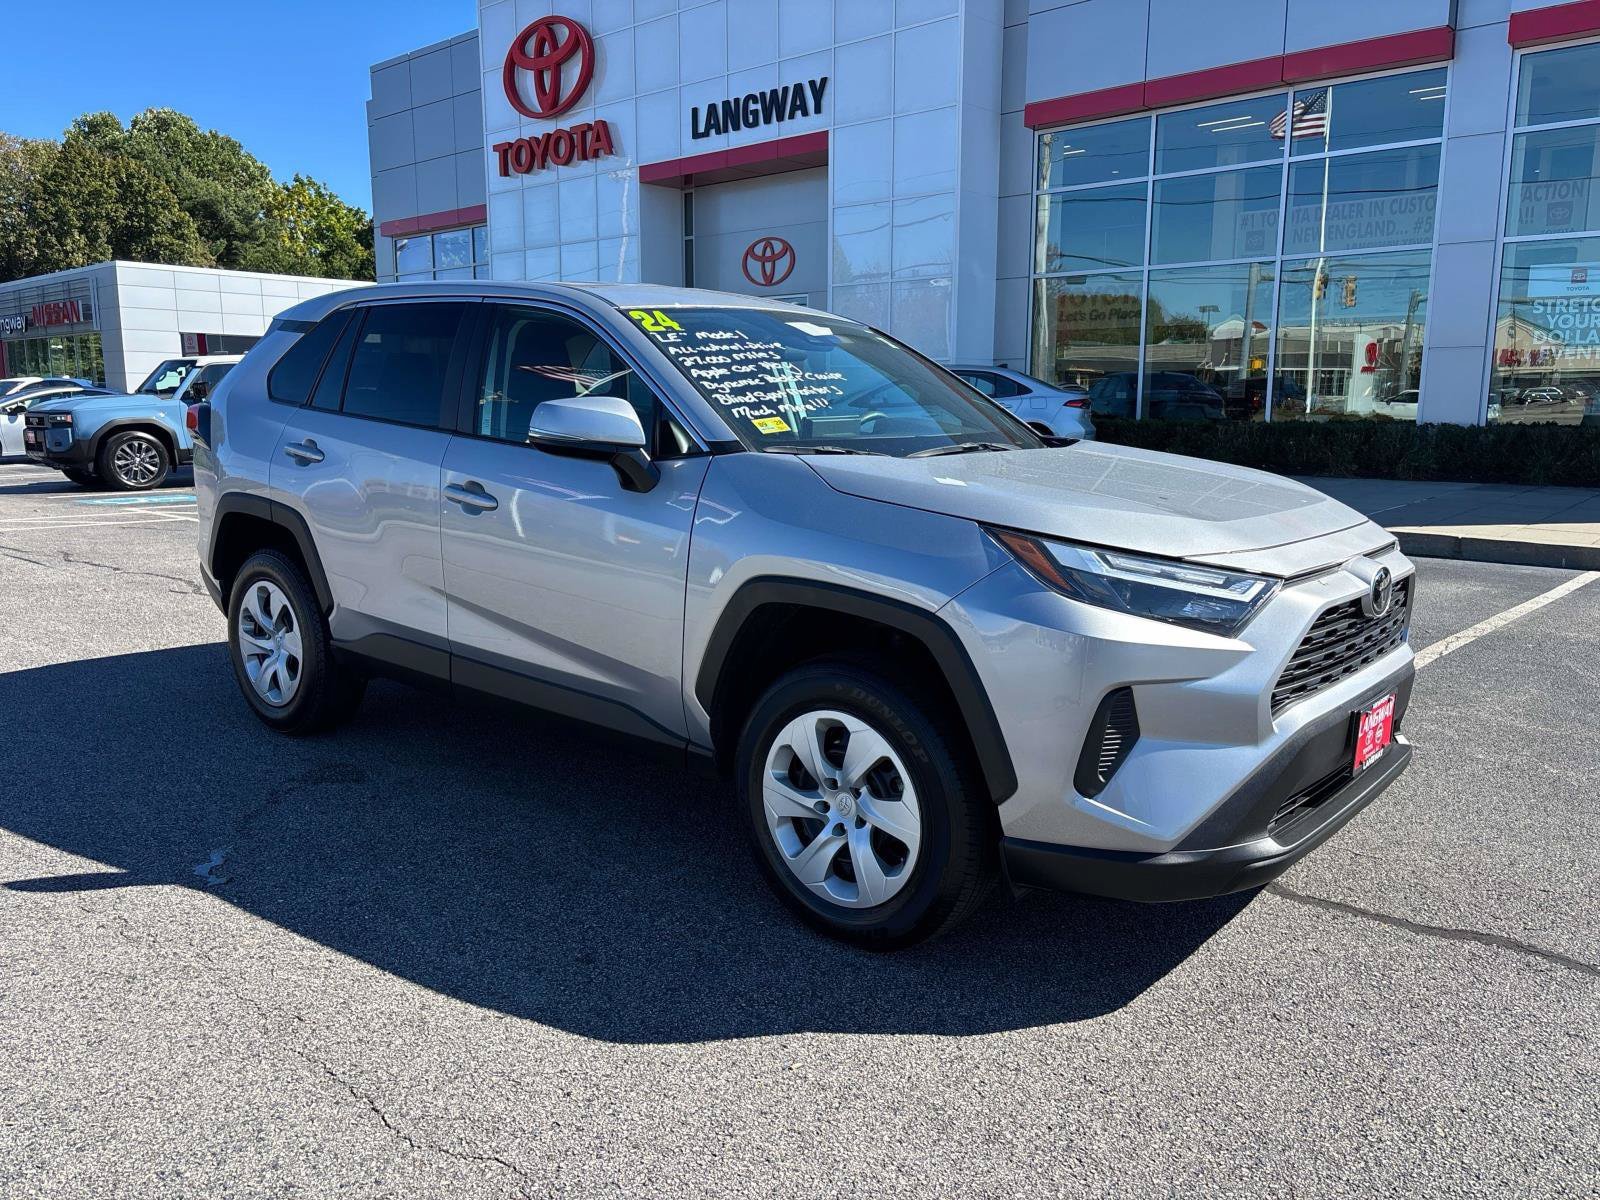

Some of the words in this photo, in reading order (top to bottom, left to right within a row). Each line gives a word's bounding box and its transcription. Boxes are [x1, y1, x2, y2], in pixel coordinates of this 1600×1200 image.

[691, 76, 828, 140] LANGWAY
[493, 119, 615, 177] TOYOTA
[1520, 181, 1585, 202] ACTION
[1369, 199, 1385, 218] IN
[1058, 309, 1086, 322] Let's
[1088, 308, 1106, 321] Go
[1107, 305, 1142, 321] Place
[1532, 297, 1600, 314] STRETC
[0, 316, 27, 334] ngway
[32, 299, 84, 327] NISSAN
[629, 310, 683, 332] 24
[1546, 313, 1600, 329] YOUR
[695, 329, 749, 340] Model
[690, 366, 731, 379] Apple
[700, 378, 766, 393] Dynamic
[804, 372, 848, 382] Cruise
[712, 391, 759, 405] Blind
[731, 404, 777, 420] Much
[855, 687, 930, 763] DUNLOP
[1358, 697, 1395, 737] LANGWAY
